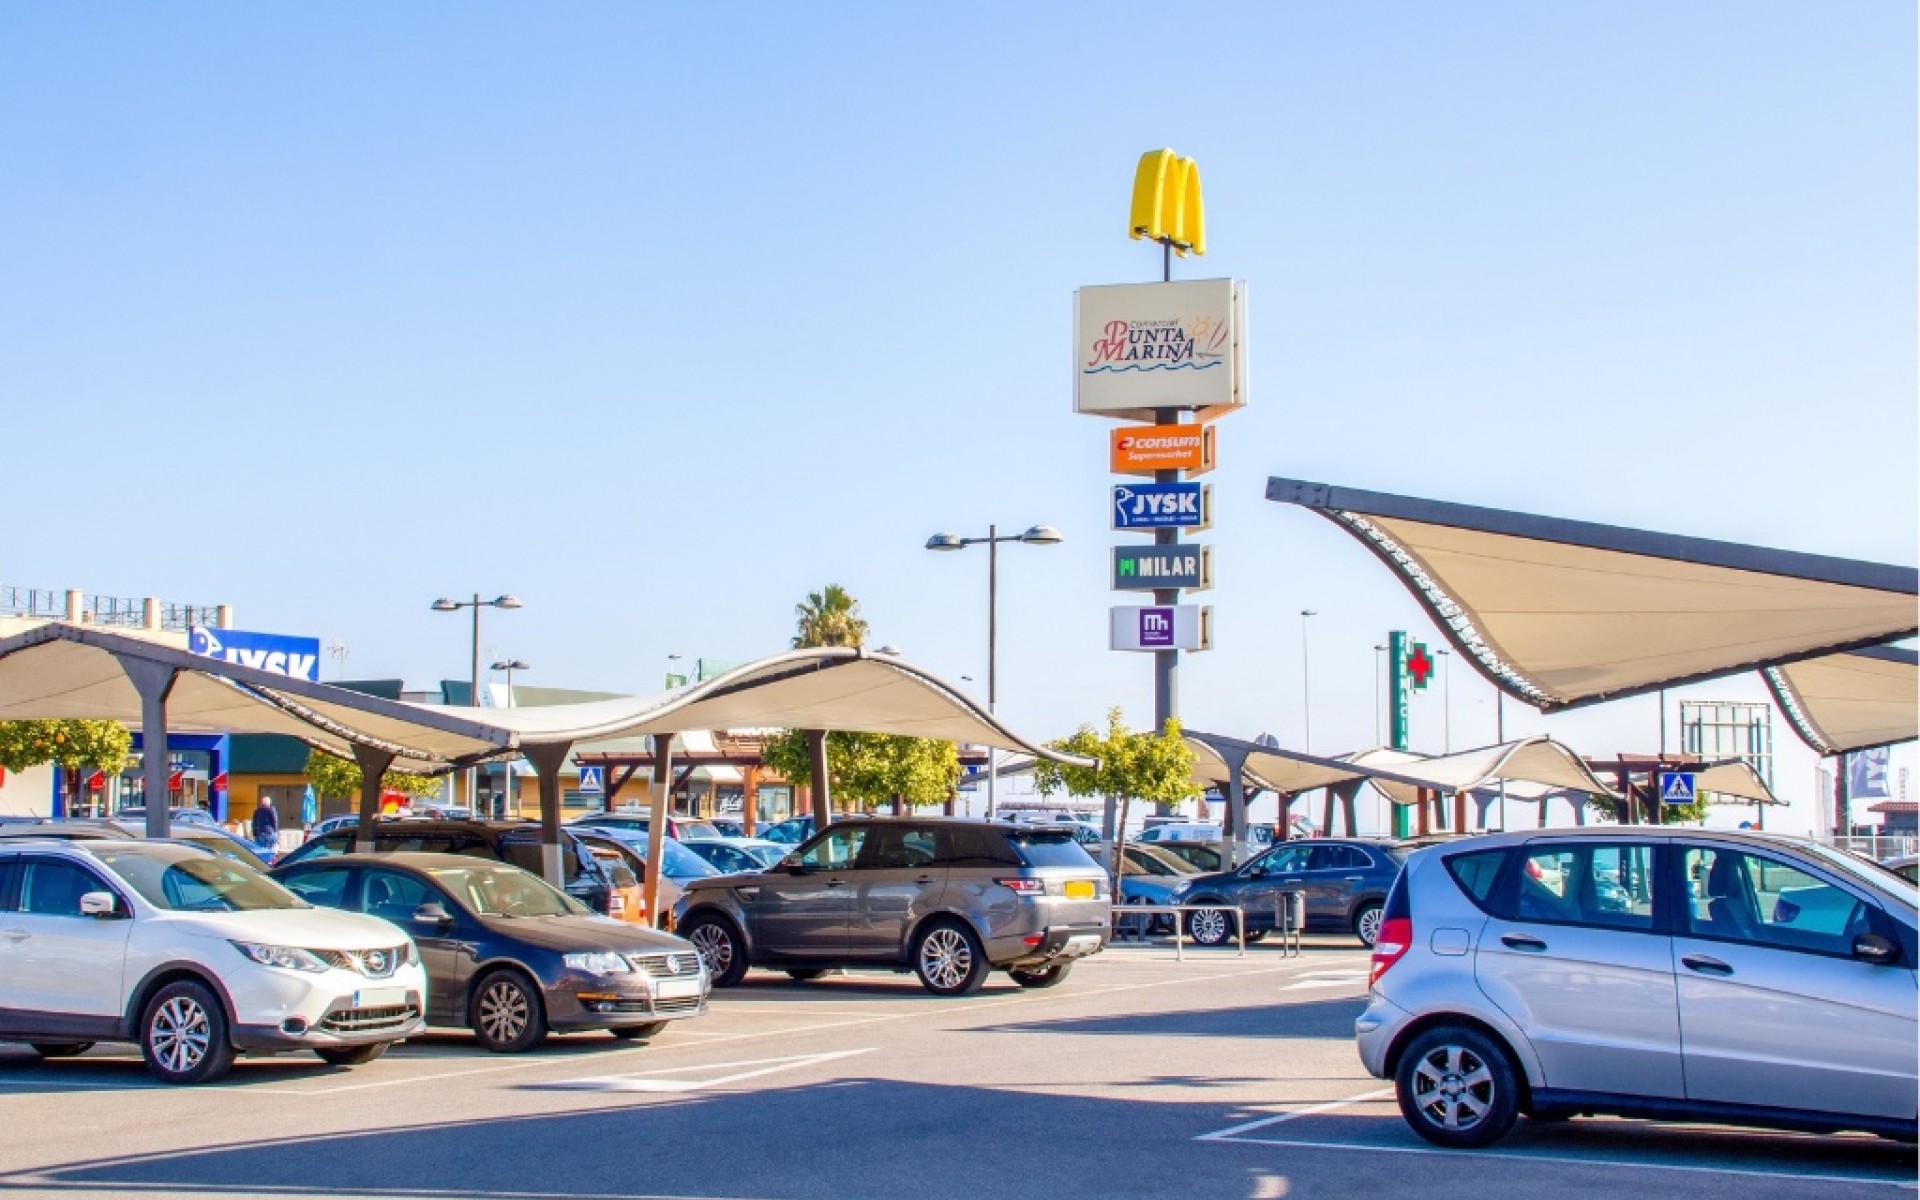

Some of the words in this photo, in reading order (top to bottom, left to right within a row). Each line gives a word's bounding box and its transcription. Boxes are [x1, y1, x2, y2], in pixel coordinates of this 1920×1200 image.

[1104, 320, 1186, 345] PUNTA
[1089, 338, 1195, 366] MARINA
[1136, 436, 1200, 449] consum
[1128, 450, 1192, 461] Supermarket
[1132, 493, 1197, 514] JYSK
[1139, 557, 1196, 576] MILAR
